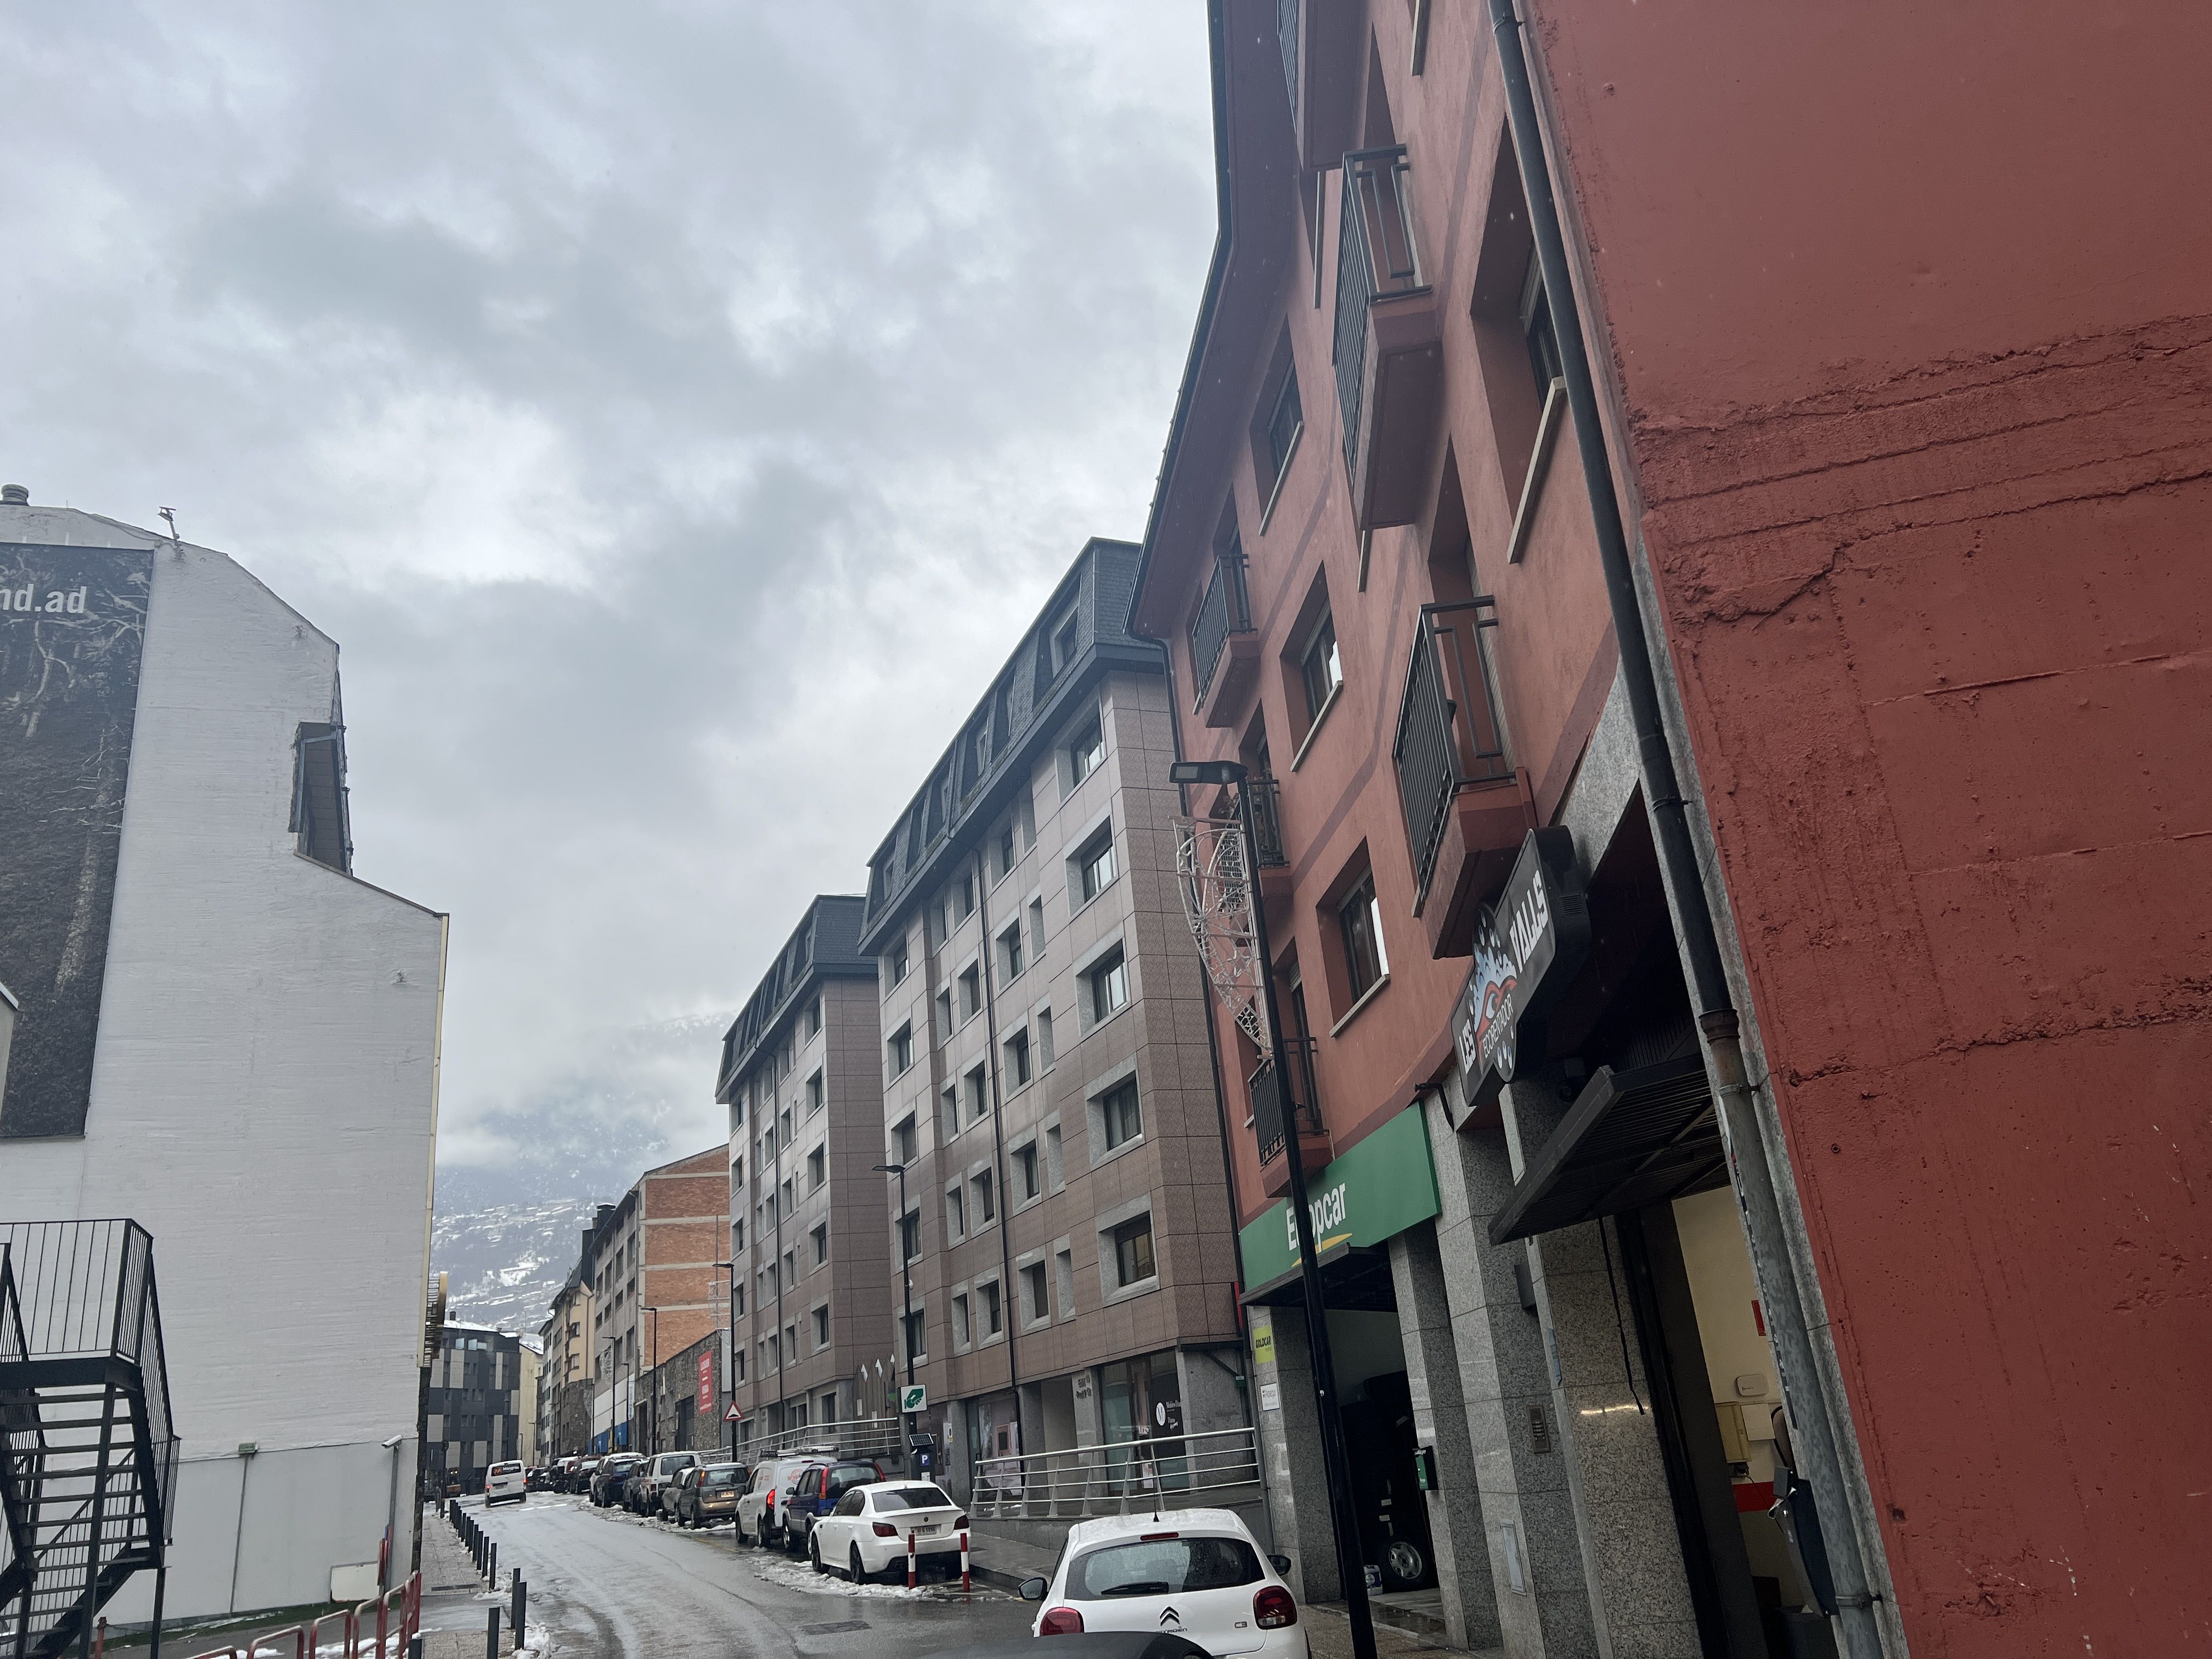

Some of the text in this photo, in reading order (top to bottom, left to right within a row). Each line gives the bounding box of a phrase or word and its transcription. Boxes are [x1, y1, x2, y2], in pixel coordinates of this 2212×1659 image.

[1459, 870, 1548, 1074] LES VALLS
[1482, 994, 1513, 1058] ECORENTADOR
[1286, 1183, 1346, 1252] Eopcar
[1255, 1335, 1272, 1348] GOLDCAR
[922, 1455, 928, 1464] P
